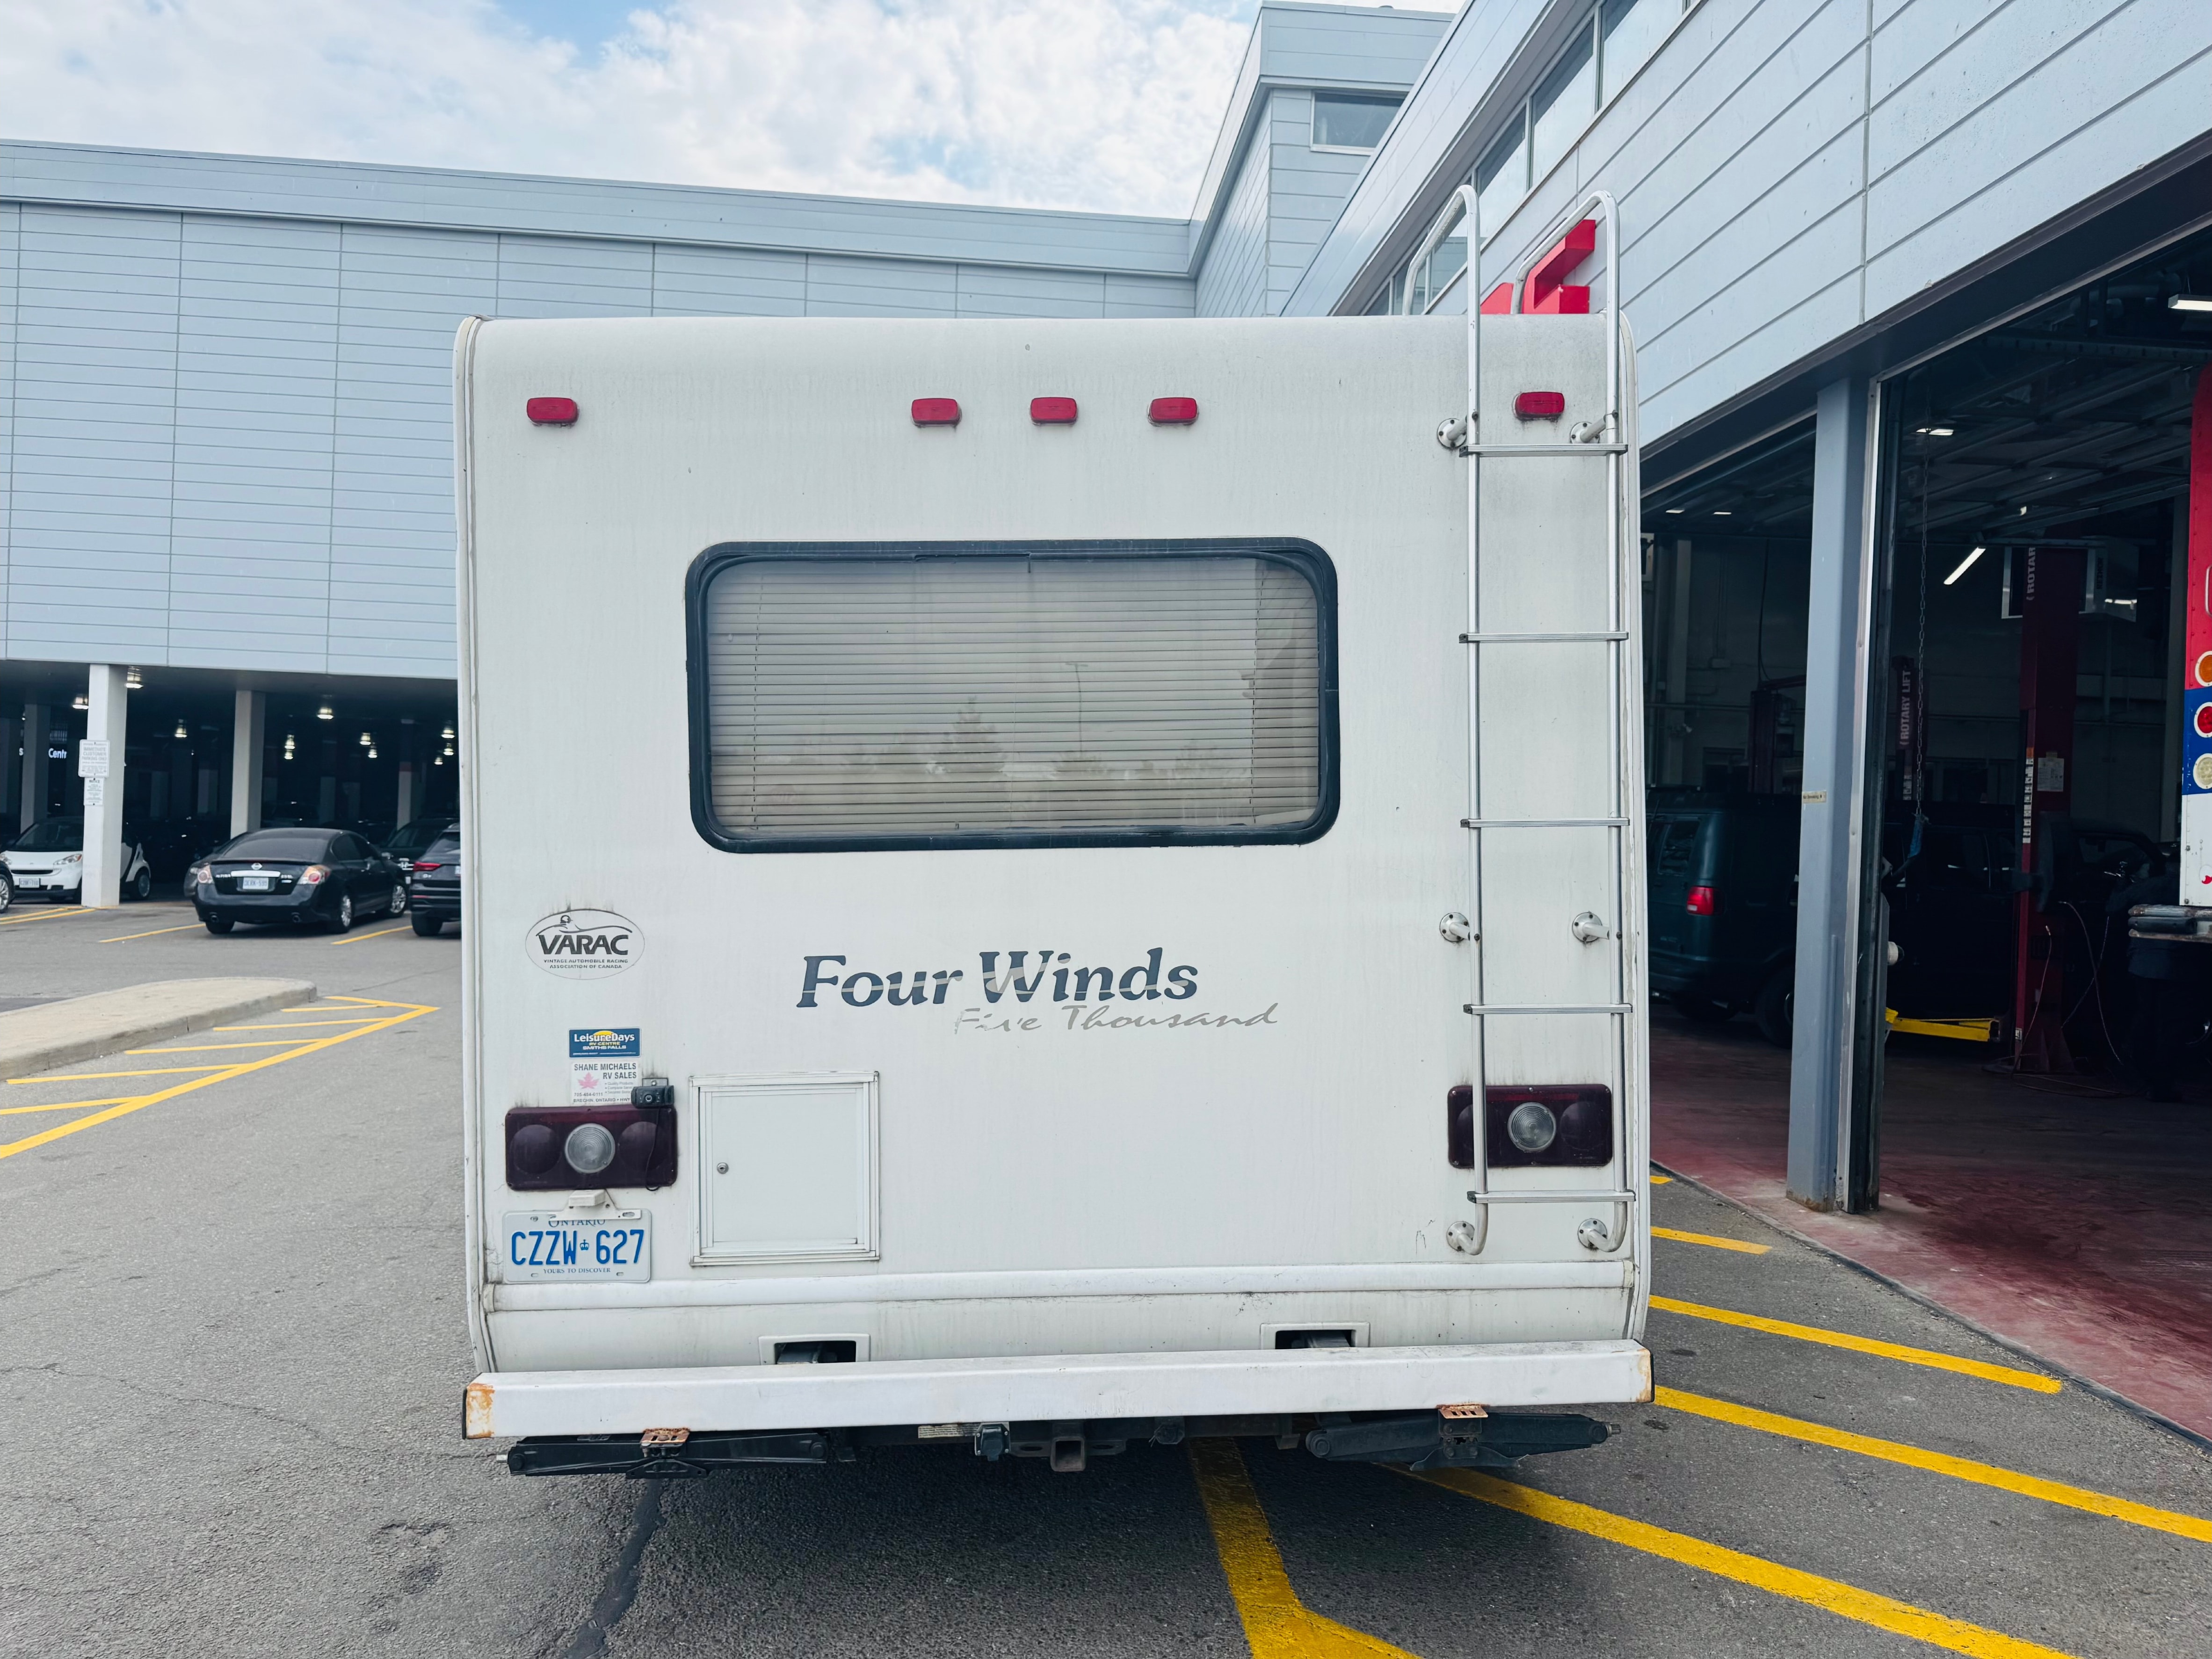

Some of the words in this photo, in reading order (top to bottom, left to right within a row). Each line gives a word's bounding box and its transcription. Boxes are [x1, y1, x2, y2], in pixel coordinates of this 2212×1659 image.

[1902, 670, 1911, 693] LIFT
[1900, 696, 1910, 740] ROTARY
[538, 934, 629, 955] VARAC
[796, 954, 963, 1008] Four
[979, 946, 1199, 1004] Winds
[1061, 1002, 1279, 1031] Thousand
[574, 1032, 635, 1042] LeisureDays
[511, 1230, 577, 1266] CZZW
[595, 1229, 645, 1264] 627
